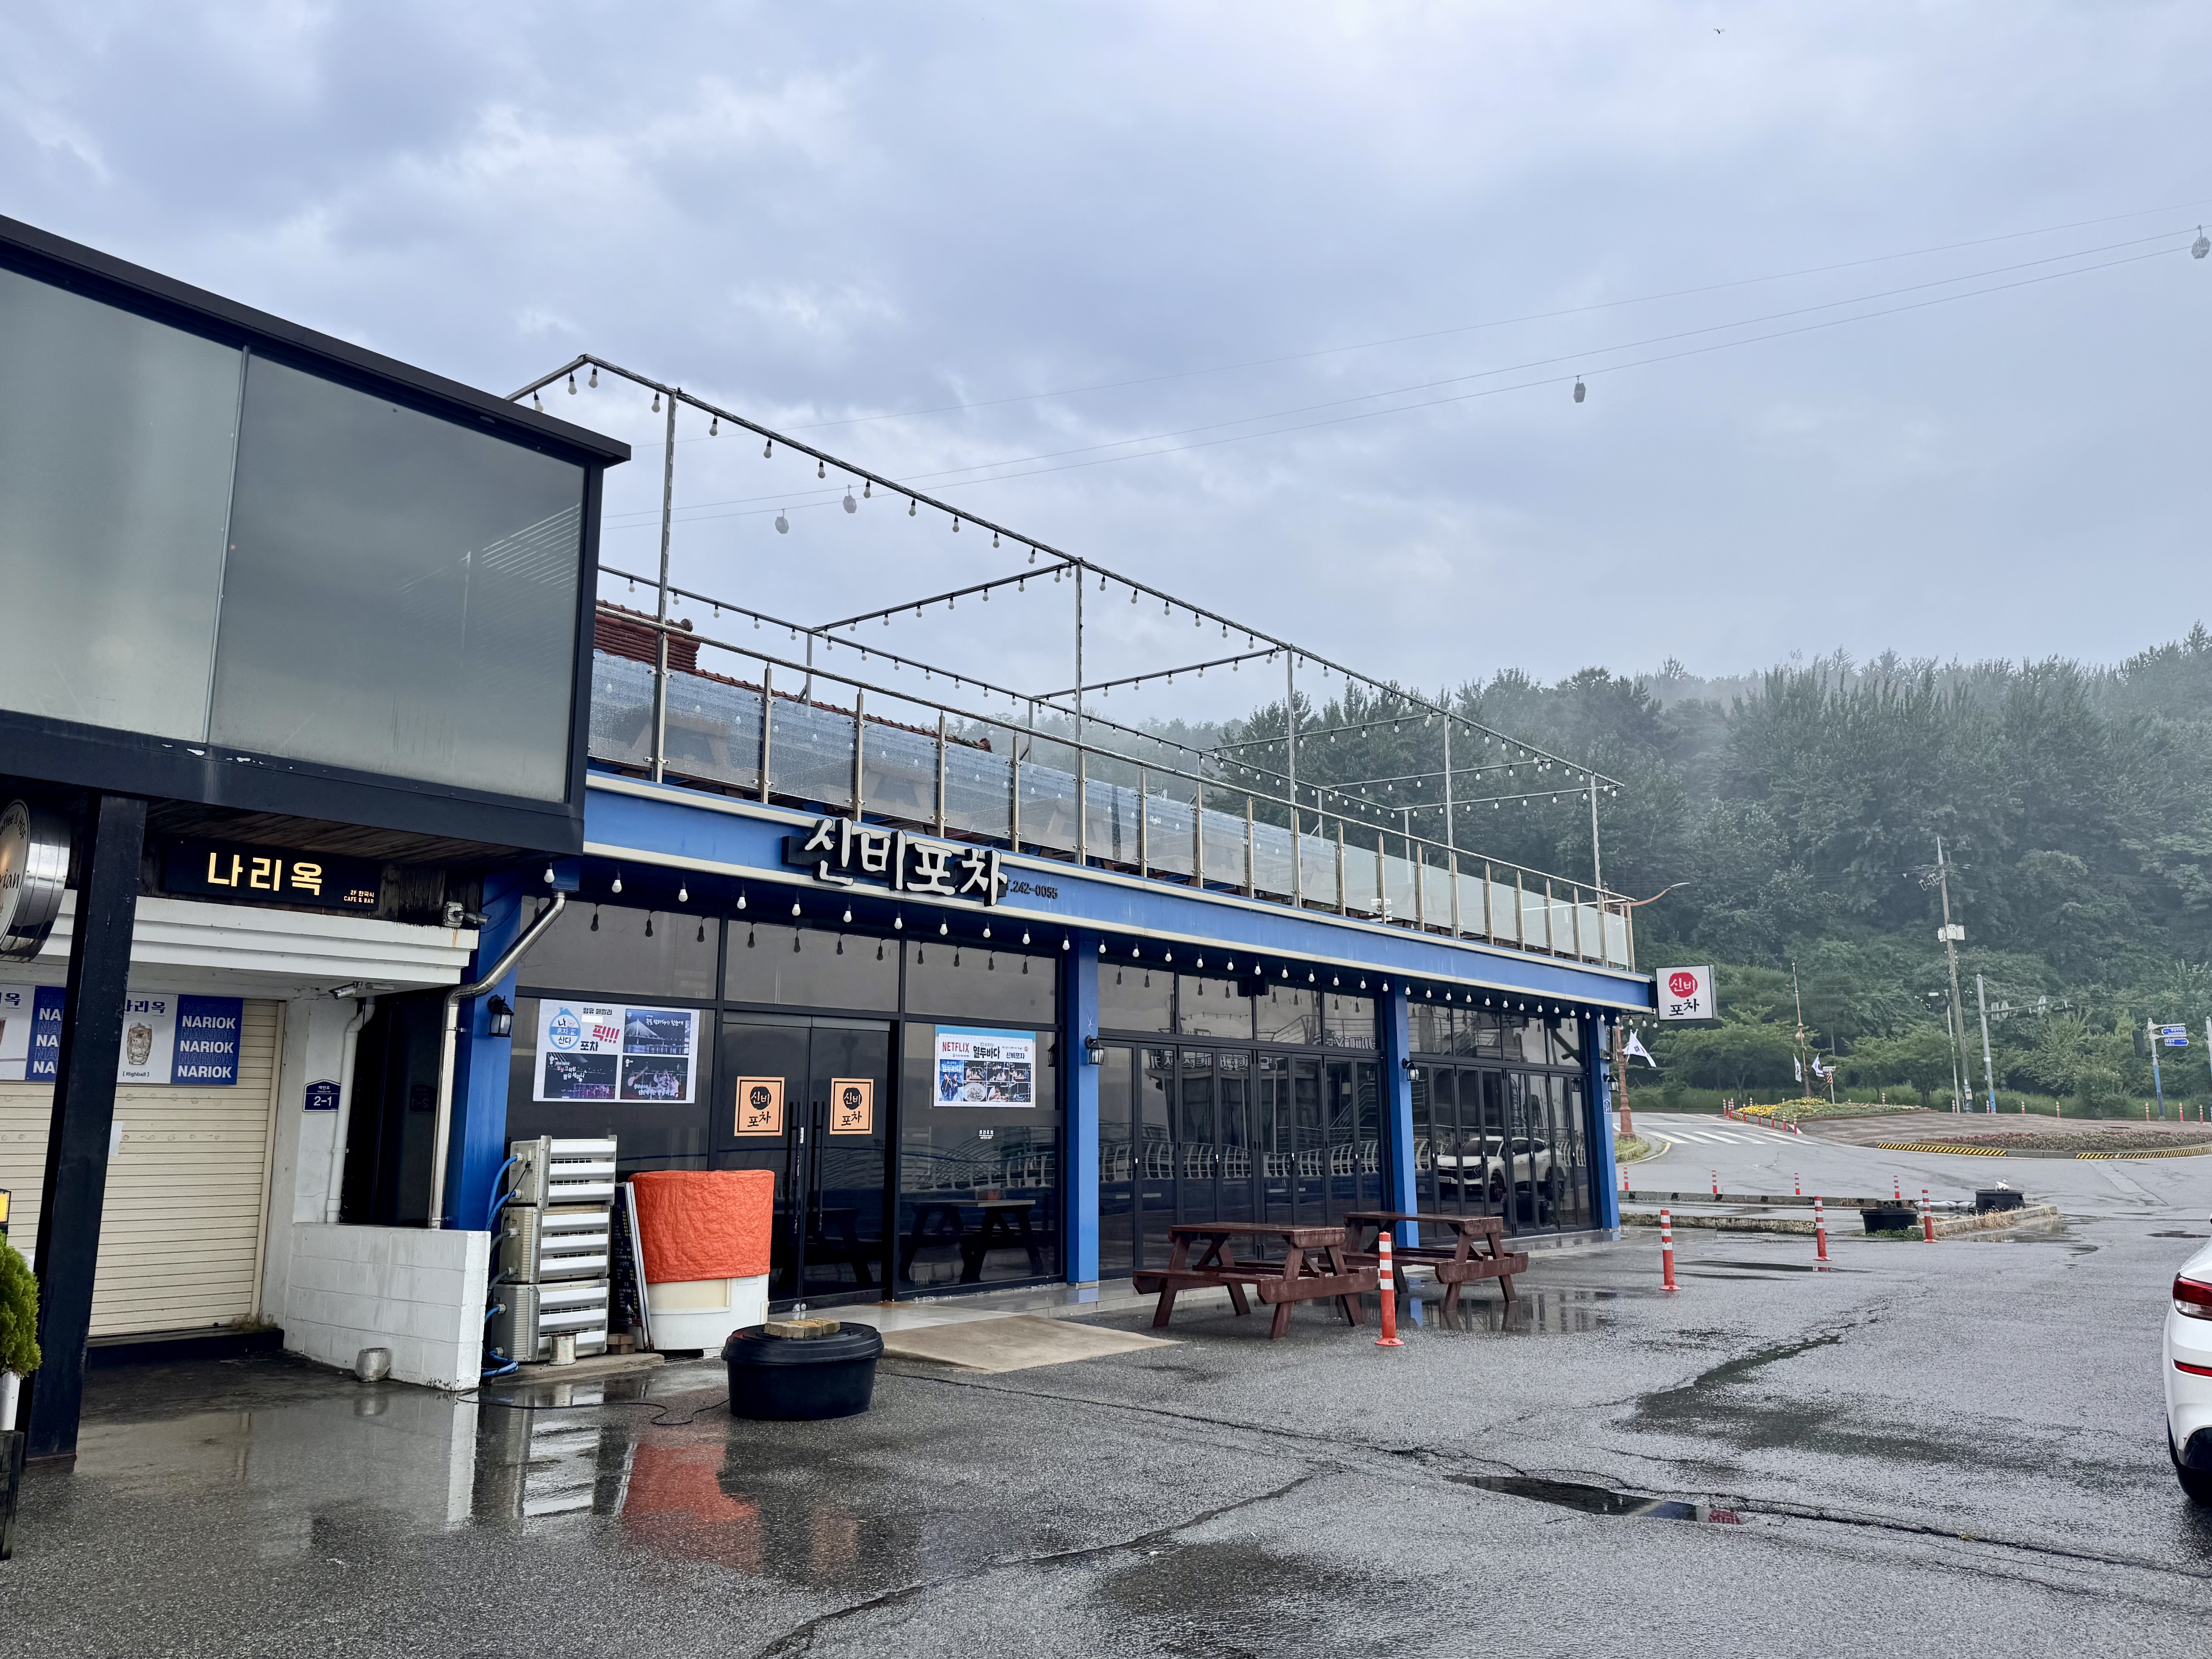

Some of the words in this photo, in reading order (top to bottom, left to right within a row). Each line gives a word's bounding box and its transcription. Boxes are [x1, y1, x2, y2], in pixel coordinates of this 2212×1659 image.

[0, 815, 14, 835] offee
[18, 815, 26, 840] HOF
[805, 817, 1008, 907] 신비포차
[208, 852, 322, 896] 나리옥
[1670, 977, 1695, 992] 신비
[0, 992, 20, 1006] 옥
[1669, 998, 1700, 1016] 포차
[182, 1016, 236, 1029] NARIOK
[558, 1018, 566, 1026] 나
[181, 1028, 235, 1041] NARIOK
[558, 1036, 571, 1044] 산다
[593, 1025, 620, 1044] 픽!!!
[180, 1040, 234, 1053] NARIOK
[580, 1041, 598, 1051] 포차
[942, 1042, 969, 1053] NETFLIX
[973, 1046, 1000, 1059] 열두바다
[179, 1053, 233, 1066] NARIOK
[178, 1065, 232, 1078] NARIOK
[314, 1096, 332, 1106] 2-1
[751, 1091, 770, 1105] 신비
[844, 1092, 860, 1105] 신비
[747, 1111, 771, 1127] 포차
[841, 1111, 862, 1126] 포차
